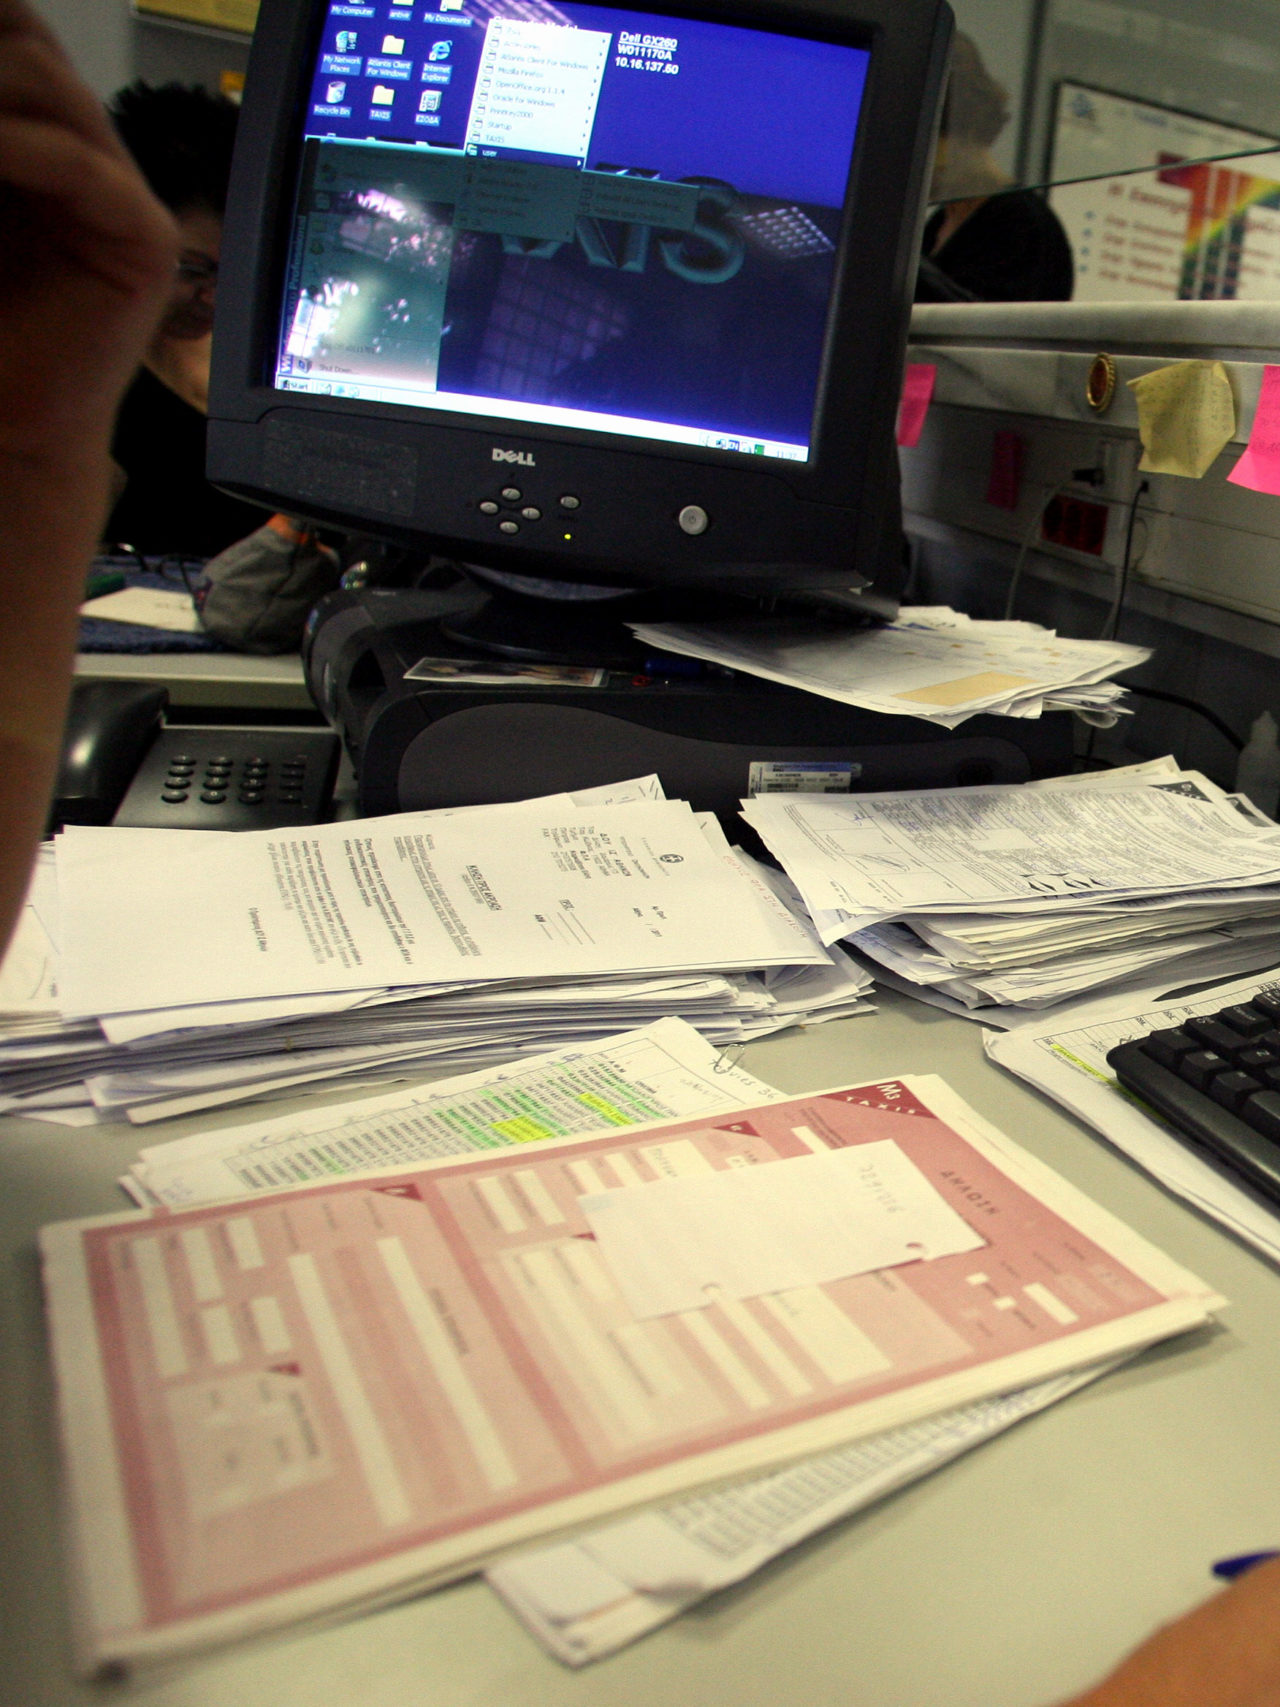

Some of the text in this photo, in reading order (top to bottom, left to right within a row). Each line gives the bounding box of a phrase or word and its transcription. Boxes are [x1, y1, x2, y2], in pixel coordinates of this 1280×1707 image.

[619, 31, 678, 49] Dell GX260
[617, 44, 672, 61] W011170A
[615, 57, 680, 75] 10.16.137.60
[492, 448, 536, 467] DELL
